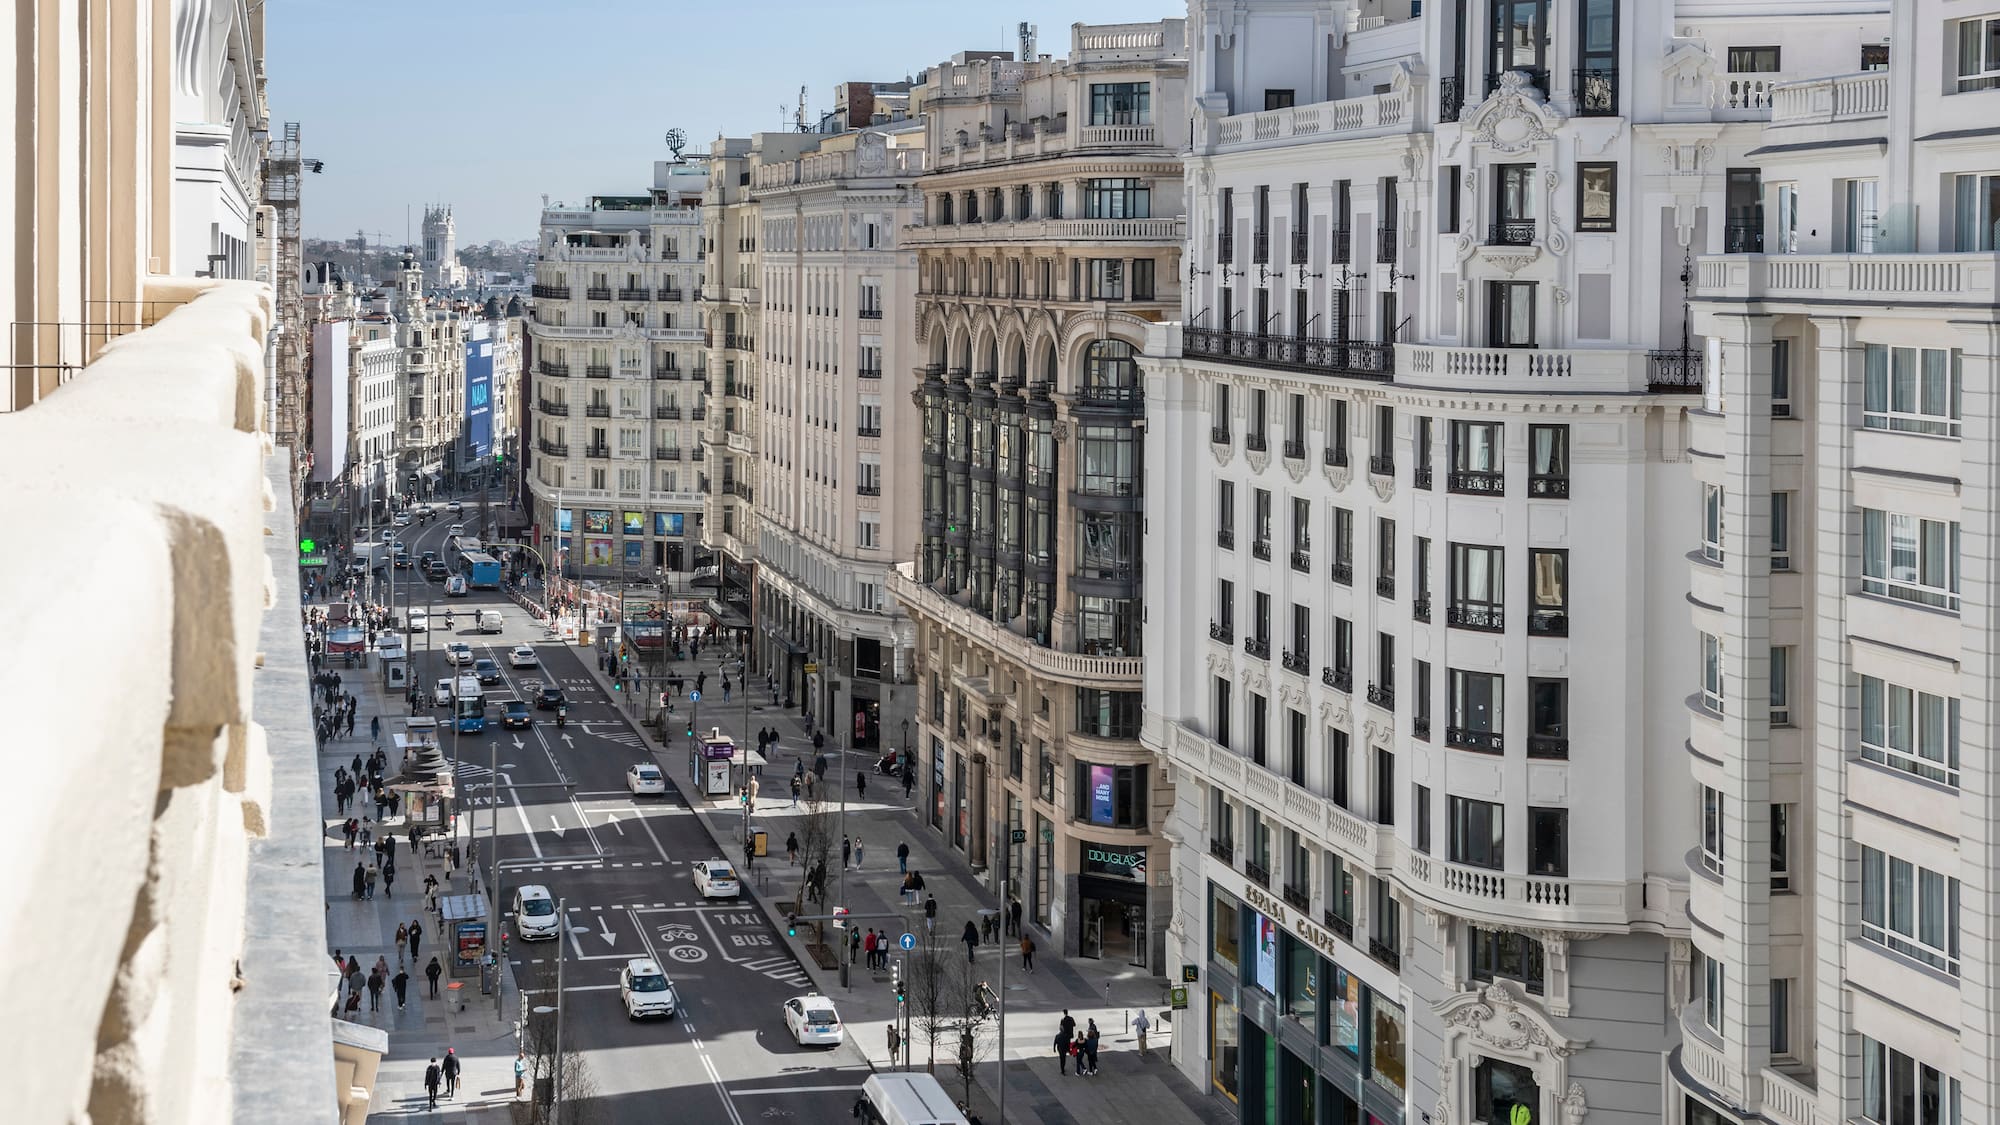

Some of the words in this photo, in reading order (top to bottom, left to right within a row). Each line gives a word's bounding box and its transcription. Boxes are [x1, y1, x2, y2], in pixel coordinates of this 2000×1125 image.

[472, 383, 488, 407] NADA
[1096, 794, 1110, 802] MORE
[1088, 849, 1136, 866] DOUGLAS
[713, 914, 762, 925] TAXI
[1245, 884, 1287, 924] ESPASA
[1296, 919, 1335, 956] CALPE
[730, 935, 772, 946] BUS
[677, 949, 699, 958] 30
